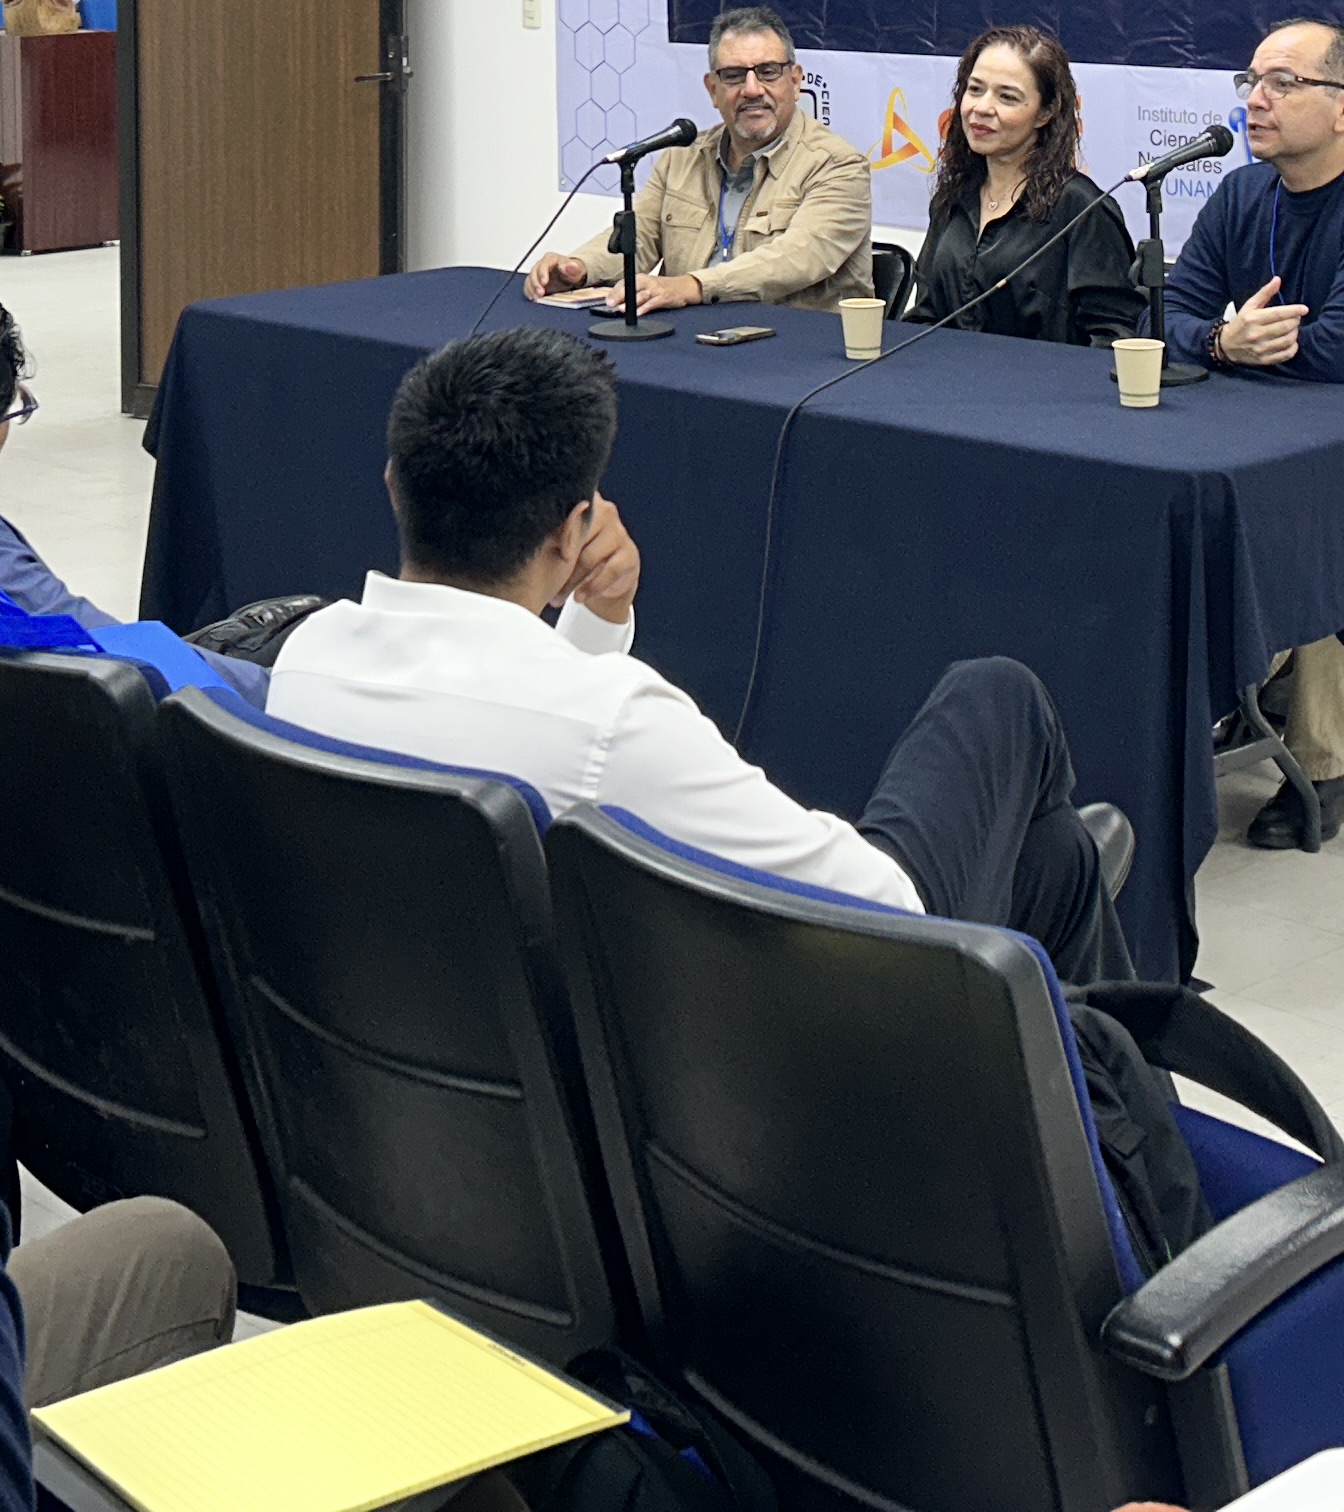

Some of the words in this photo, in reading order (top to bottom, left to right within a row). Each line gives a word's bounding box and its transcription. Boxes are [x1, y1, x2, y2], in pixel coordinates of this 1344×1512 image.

[807, 73, 824, 88] DE
[1137, 105, 1198, 125] Instituto
[1202, 110, 1223, 126] de
